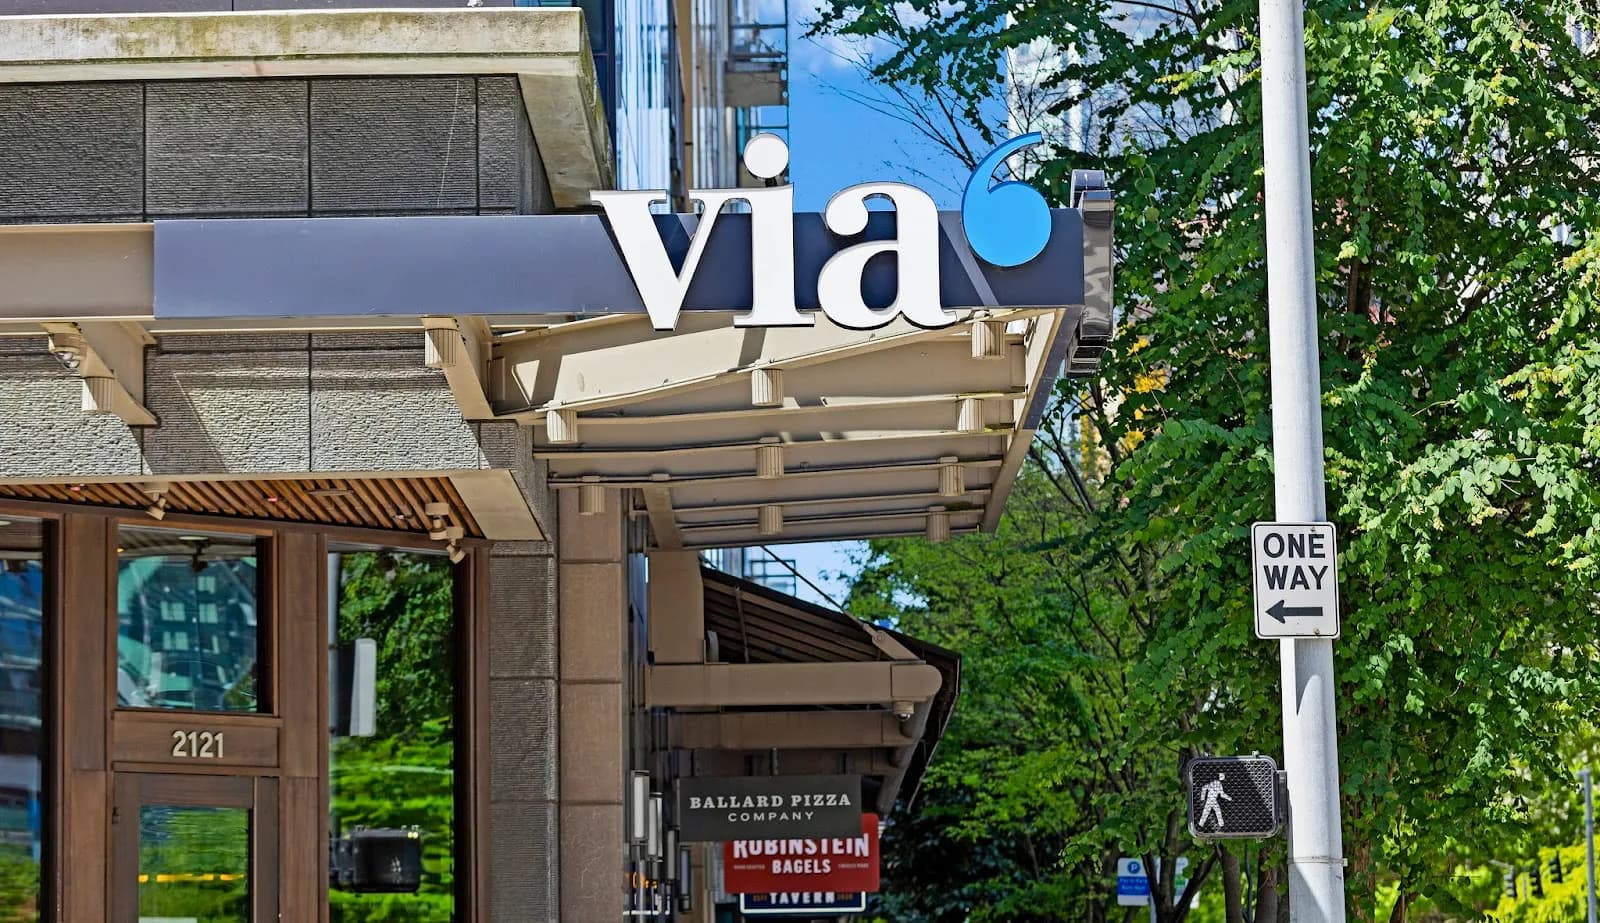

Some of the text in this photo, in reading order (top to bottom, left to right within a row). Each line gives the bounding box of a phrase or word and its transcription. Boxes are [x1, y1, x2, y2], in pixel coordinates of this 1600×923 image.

[1263, 533, 1325, 558] ONE
[1263, 565, 1328, 590] WAY
[172, 731, 224, 758] 2121
[690, 794, 851, 809] BALLARD PIZZA
[728, 811, 814, 822] COMPANY
[772, 859, 831, 874] BAGELS
[769, 892, 835, 904] TAVERN
